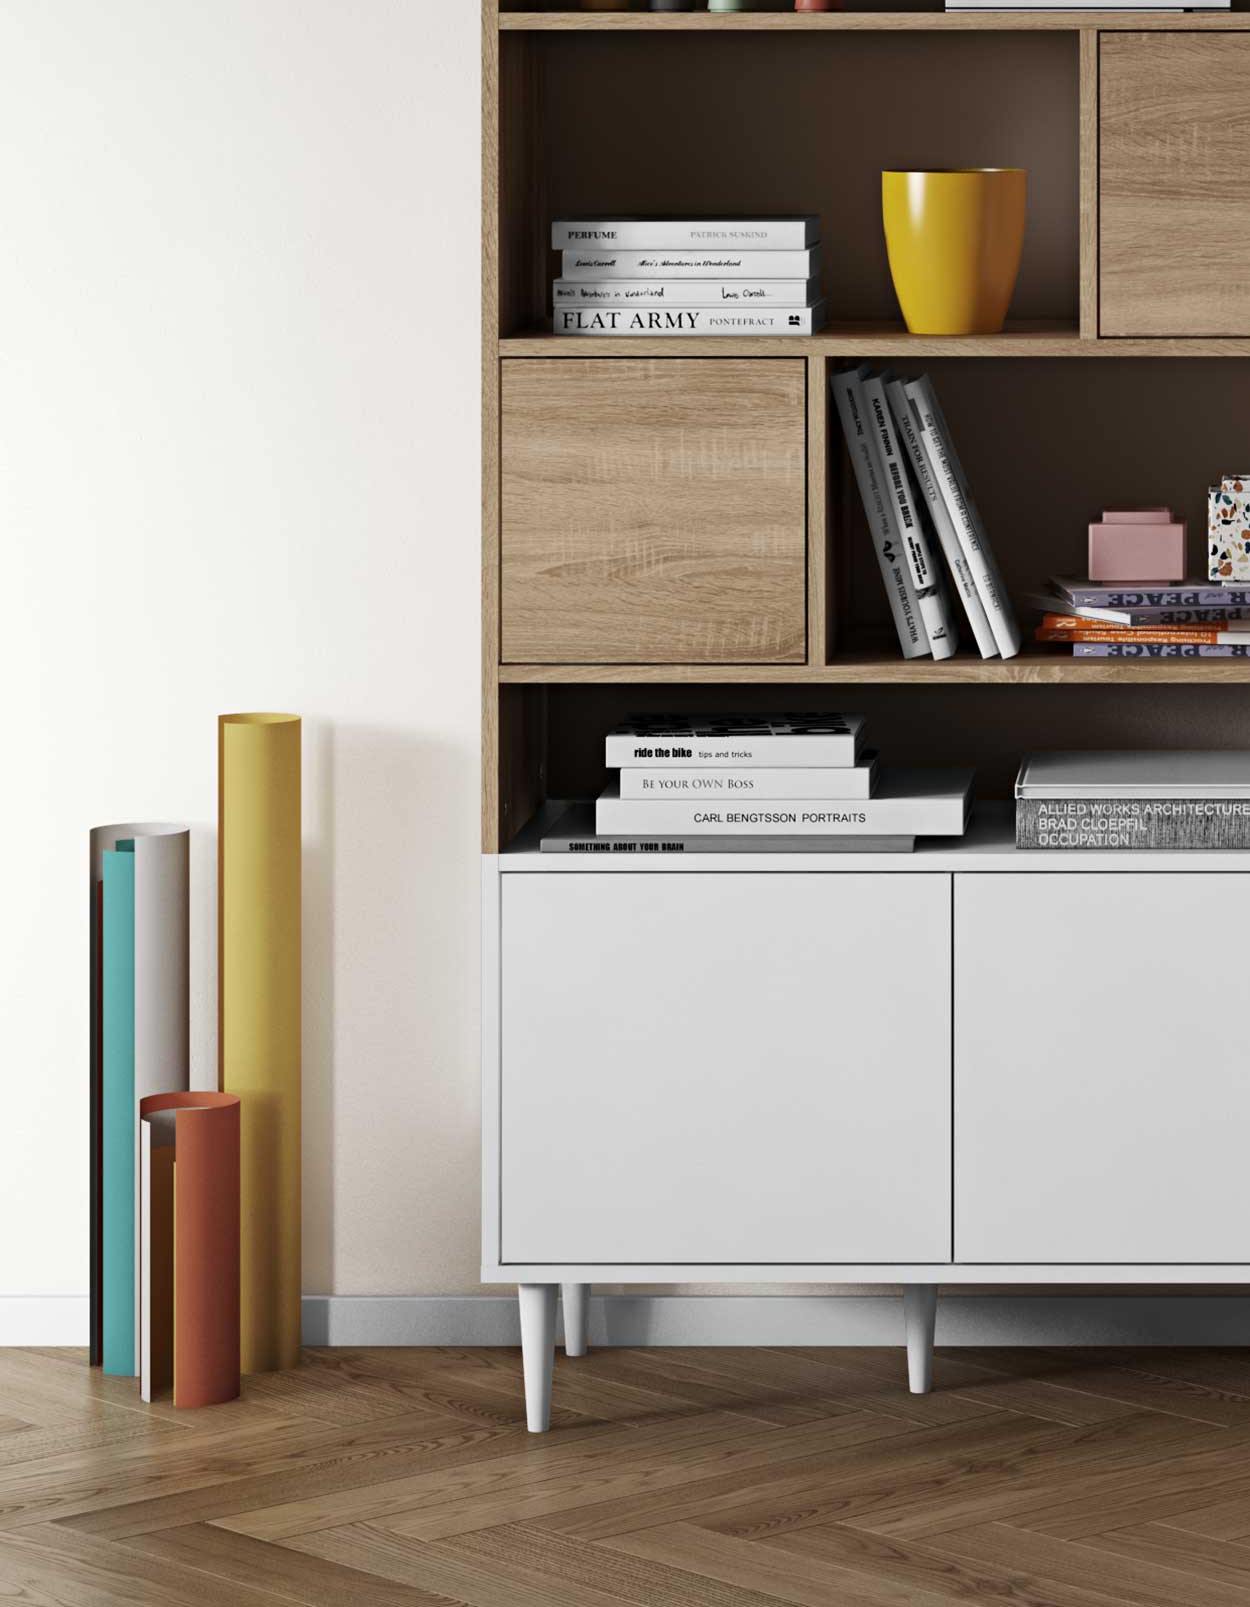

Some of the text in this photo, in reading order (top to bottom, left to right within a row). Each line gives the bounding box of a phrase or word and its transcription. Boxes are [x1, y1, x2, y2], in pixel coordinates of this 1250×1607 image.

[690, 231, 727, 239] PATRICK
[564, 312, 775, 328] FLAT ARMY PONTEFRACT
[871, 398, 886, 427] KAREN
[900, 414, 938, 502] TRAIN FOR RESULTS
[1107, 593, 1200, 605] PEACE
[1160, 608, 1241, 623] PEACE
[1108, 644, 1200, 657] PEACE
[634, 748, 692, 758] ride the bike
[692, 779, 722, 789] OWN
[1038, 803, 1086, 816] ALLIED
[1090, 803, 1141, 816] WORKS
[694, 813, 866, 823] CARL BENGTSSON PORTRAITS
[1039, 818, 1148, 831] BRAD CLOEPFIL
[1038, 833, 1130, 846] OCCUPATION
[569, 843, 684, 852] SOMETHING ABOUT YOUR BRAIN
